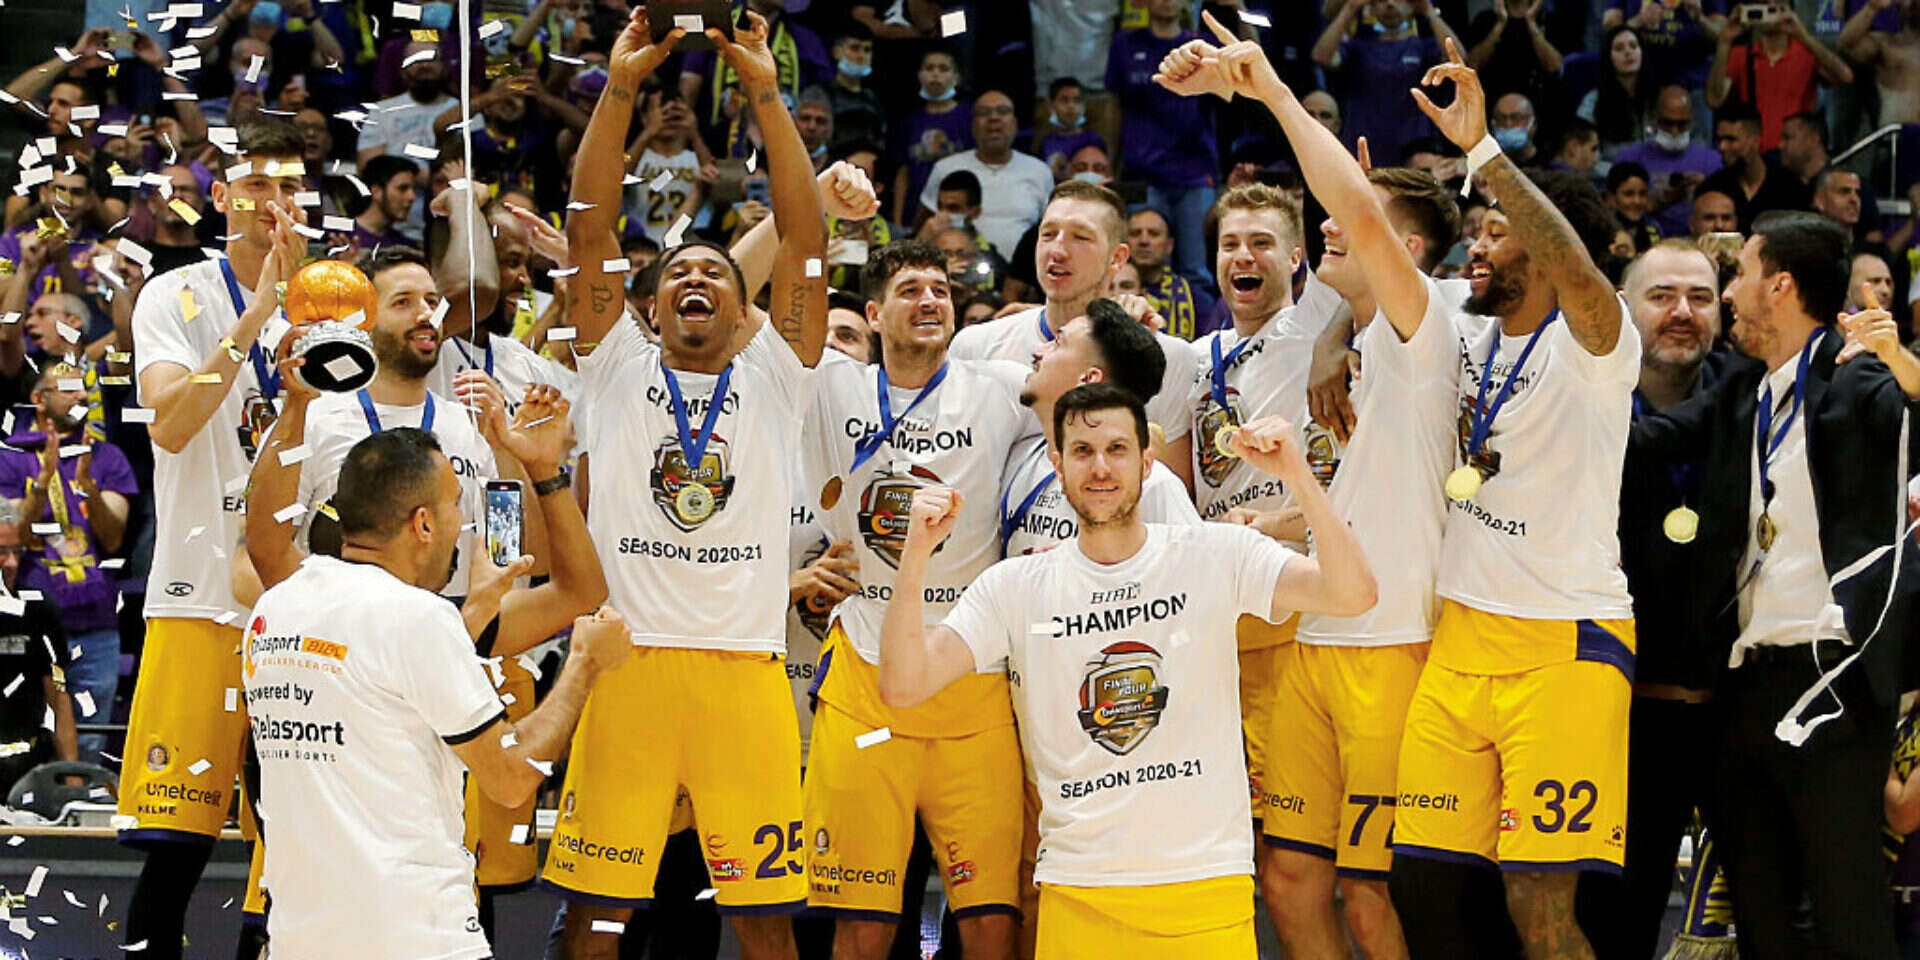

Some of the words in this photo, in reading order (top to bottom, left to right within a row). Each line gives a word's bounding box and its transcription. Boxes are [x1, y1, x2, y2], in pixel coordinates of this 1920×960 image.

[646, 385, 740, 418] CMPO
[1018, 512, 1079, 541] AMPIO
[617, 537, 691, 561] SEASON
[697, 544, 763, 564] 2020-21
[1052, 592, 1187, 638] CHAMPION
[294, 684, 314, 705] by
[1060, 772, 1132, 799] SEASON
[1136, 760, 1204, 783] 2020-21
[1532, 779, 1598, 833] 32
[753, 821, 803, 879] 25
